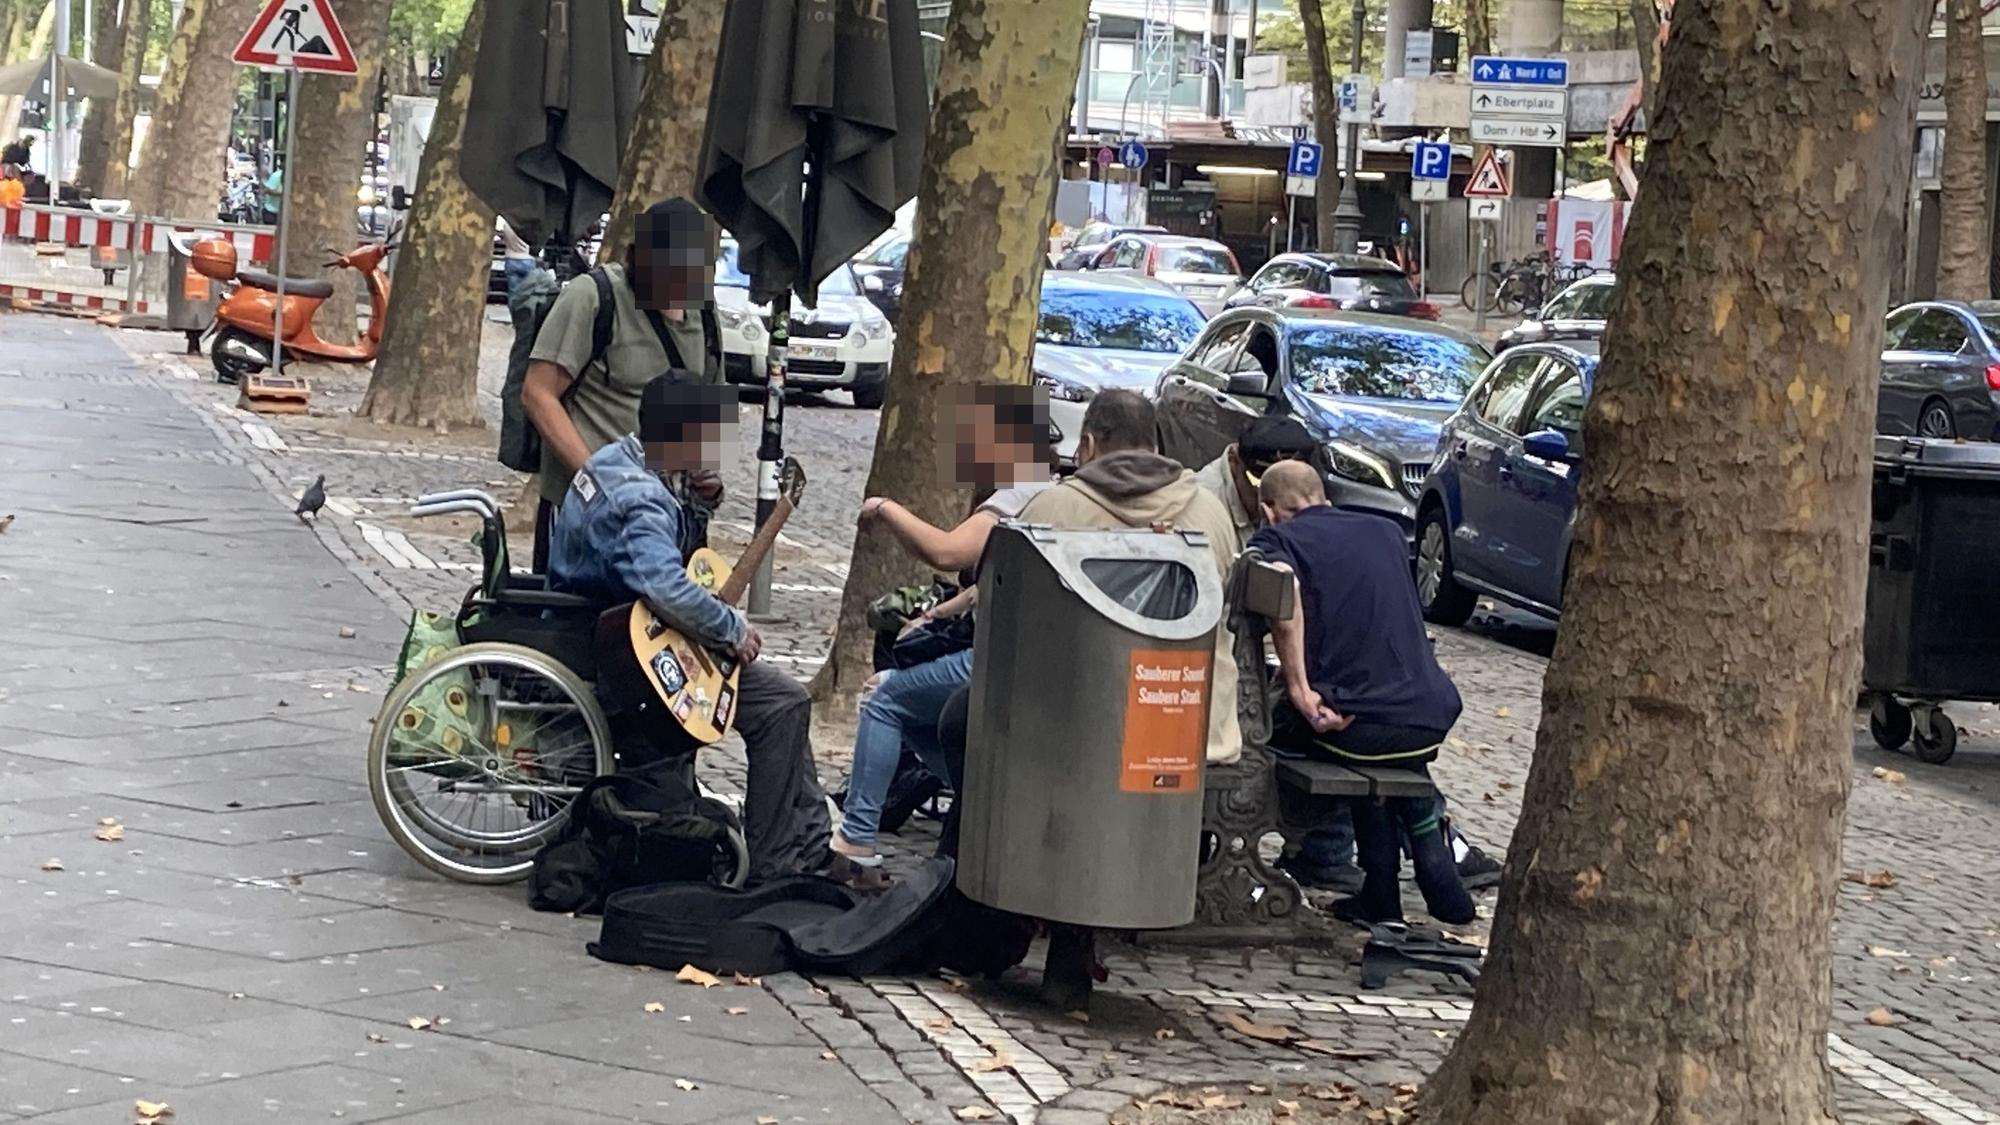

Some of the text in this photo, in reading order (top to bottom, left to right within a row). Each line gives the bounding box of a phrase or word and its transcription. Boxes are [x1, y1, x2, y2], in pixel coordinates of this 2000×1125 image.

[1495, 95, 1555, 109] Ebertplatz
[1482, 124, 1508, 135] Dom
[1520, 126, 1539, 137] Hbf
[1296, 145, 1315, 172] P
[1421, 147, 1443, 175] P
[1135, 664, 1181, 682] Sauberer
[1138, 686, 1180, 704] Saubere
